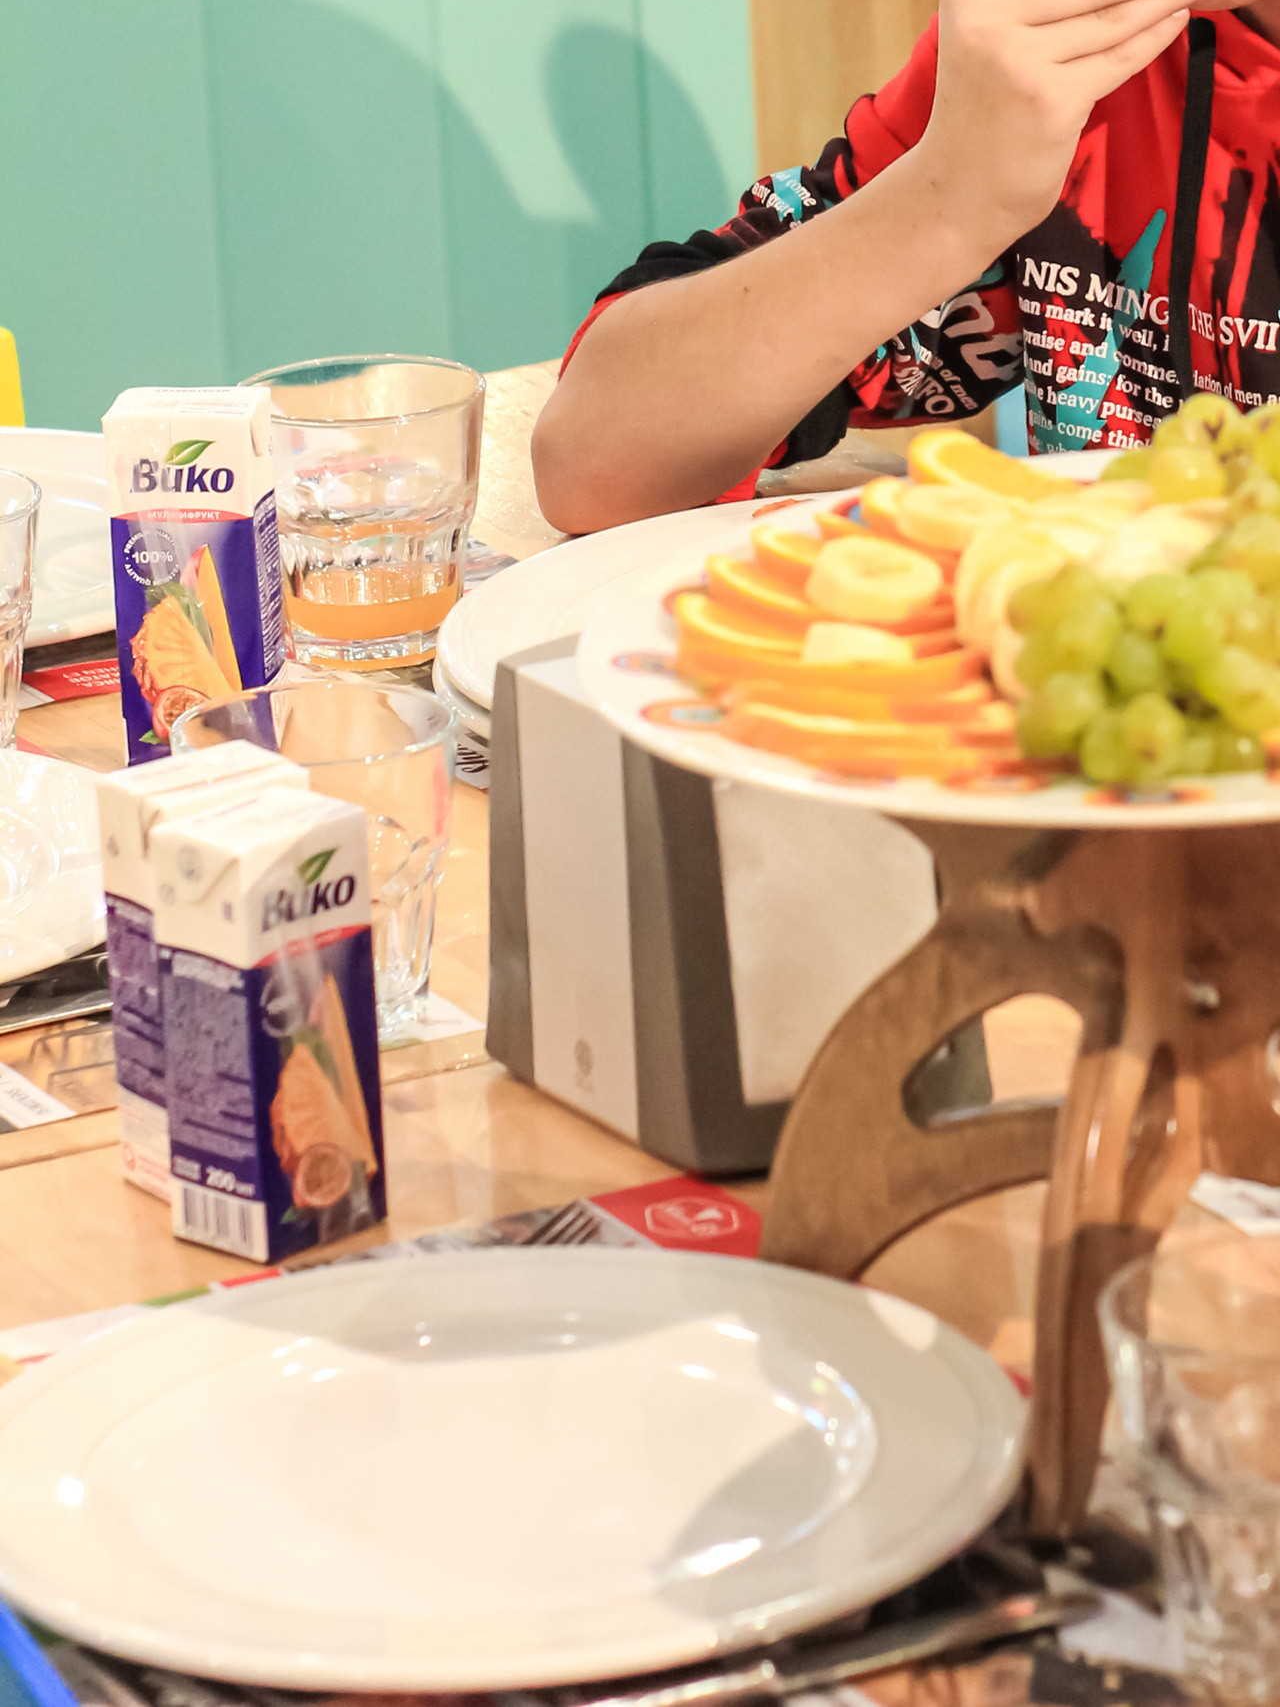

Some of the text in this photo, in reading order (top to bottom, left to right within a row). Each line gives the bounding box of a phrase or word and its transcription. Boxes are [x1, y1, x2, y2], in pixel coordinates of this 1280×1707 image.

[1045, 304, 1096, 327] mark
[1219, 315, 1280, 352] SVII
[1069, 341, 1108, 358] and
[1113, 349, 1181, 385] comme
[1235, 388, 1262, 406] men
[1047, 386, 1099, 414] heavy
[1115, 374, 1141, 396] for
[1145, 387, 1174, 409] the
[1057, 422, 1103, 444] come
[131, 551, 174, 564] 100%
